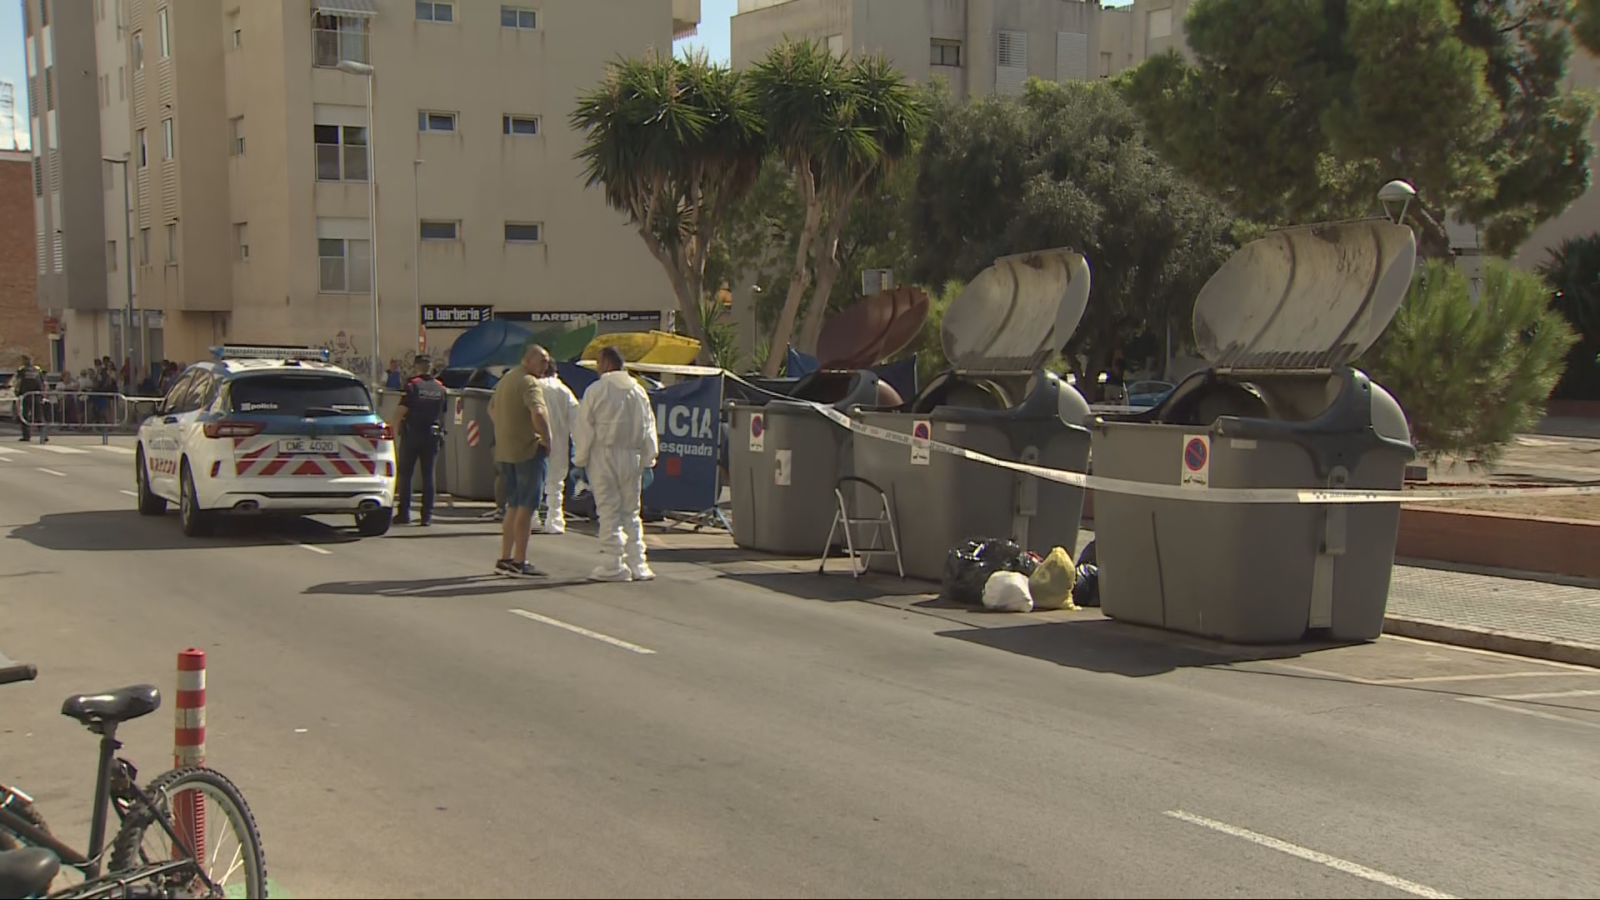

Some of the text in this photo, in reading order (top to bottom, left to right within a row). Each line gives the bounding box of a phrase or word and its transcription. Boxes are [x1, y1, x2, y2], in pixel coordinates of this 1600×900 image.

[424, 307, 480, 320] la barberia
[592, 313, 629, 321] SHOP
[657, 403, 713, 439] ICIA
[286, 441, 333, 451] CME 4020
